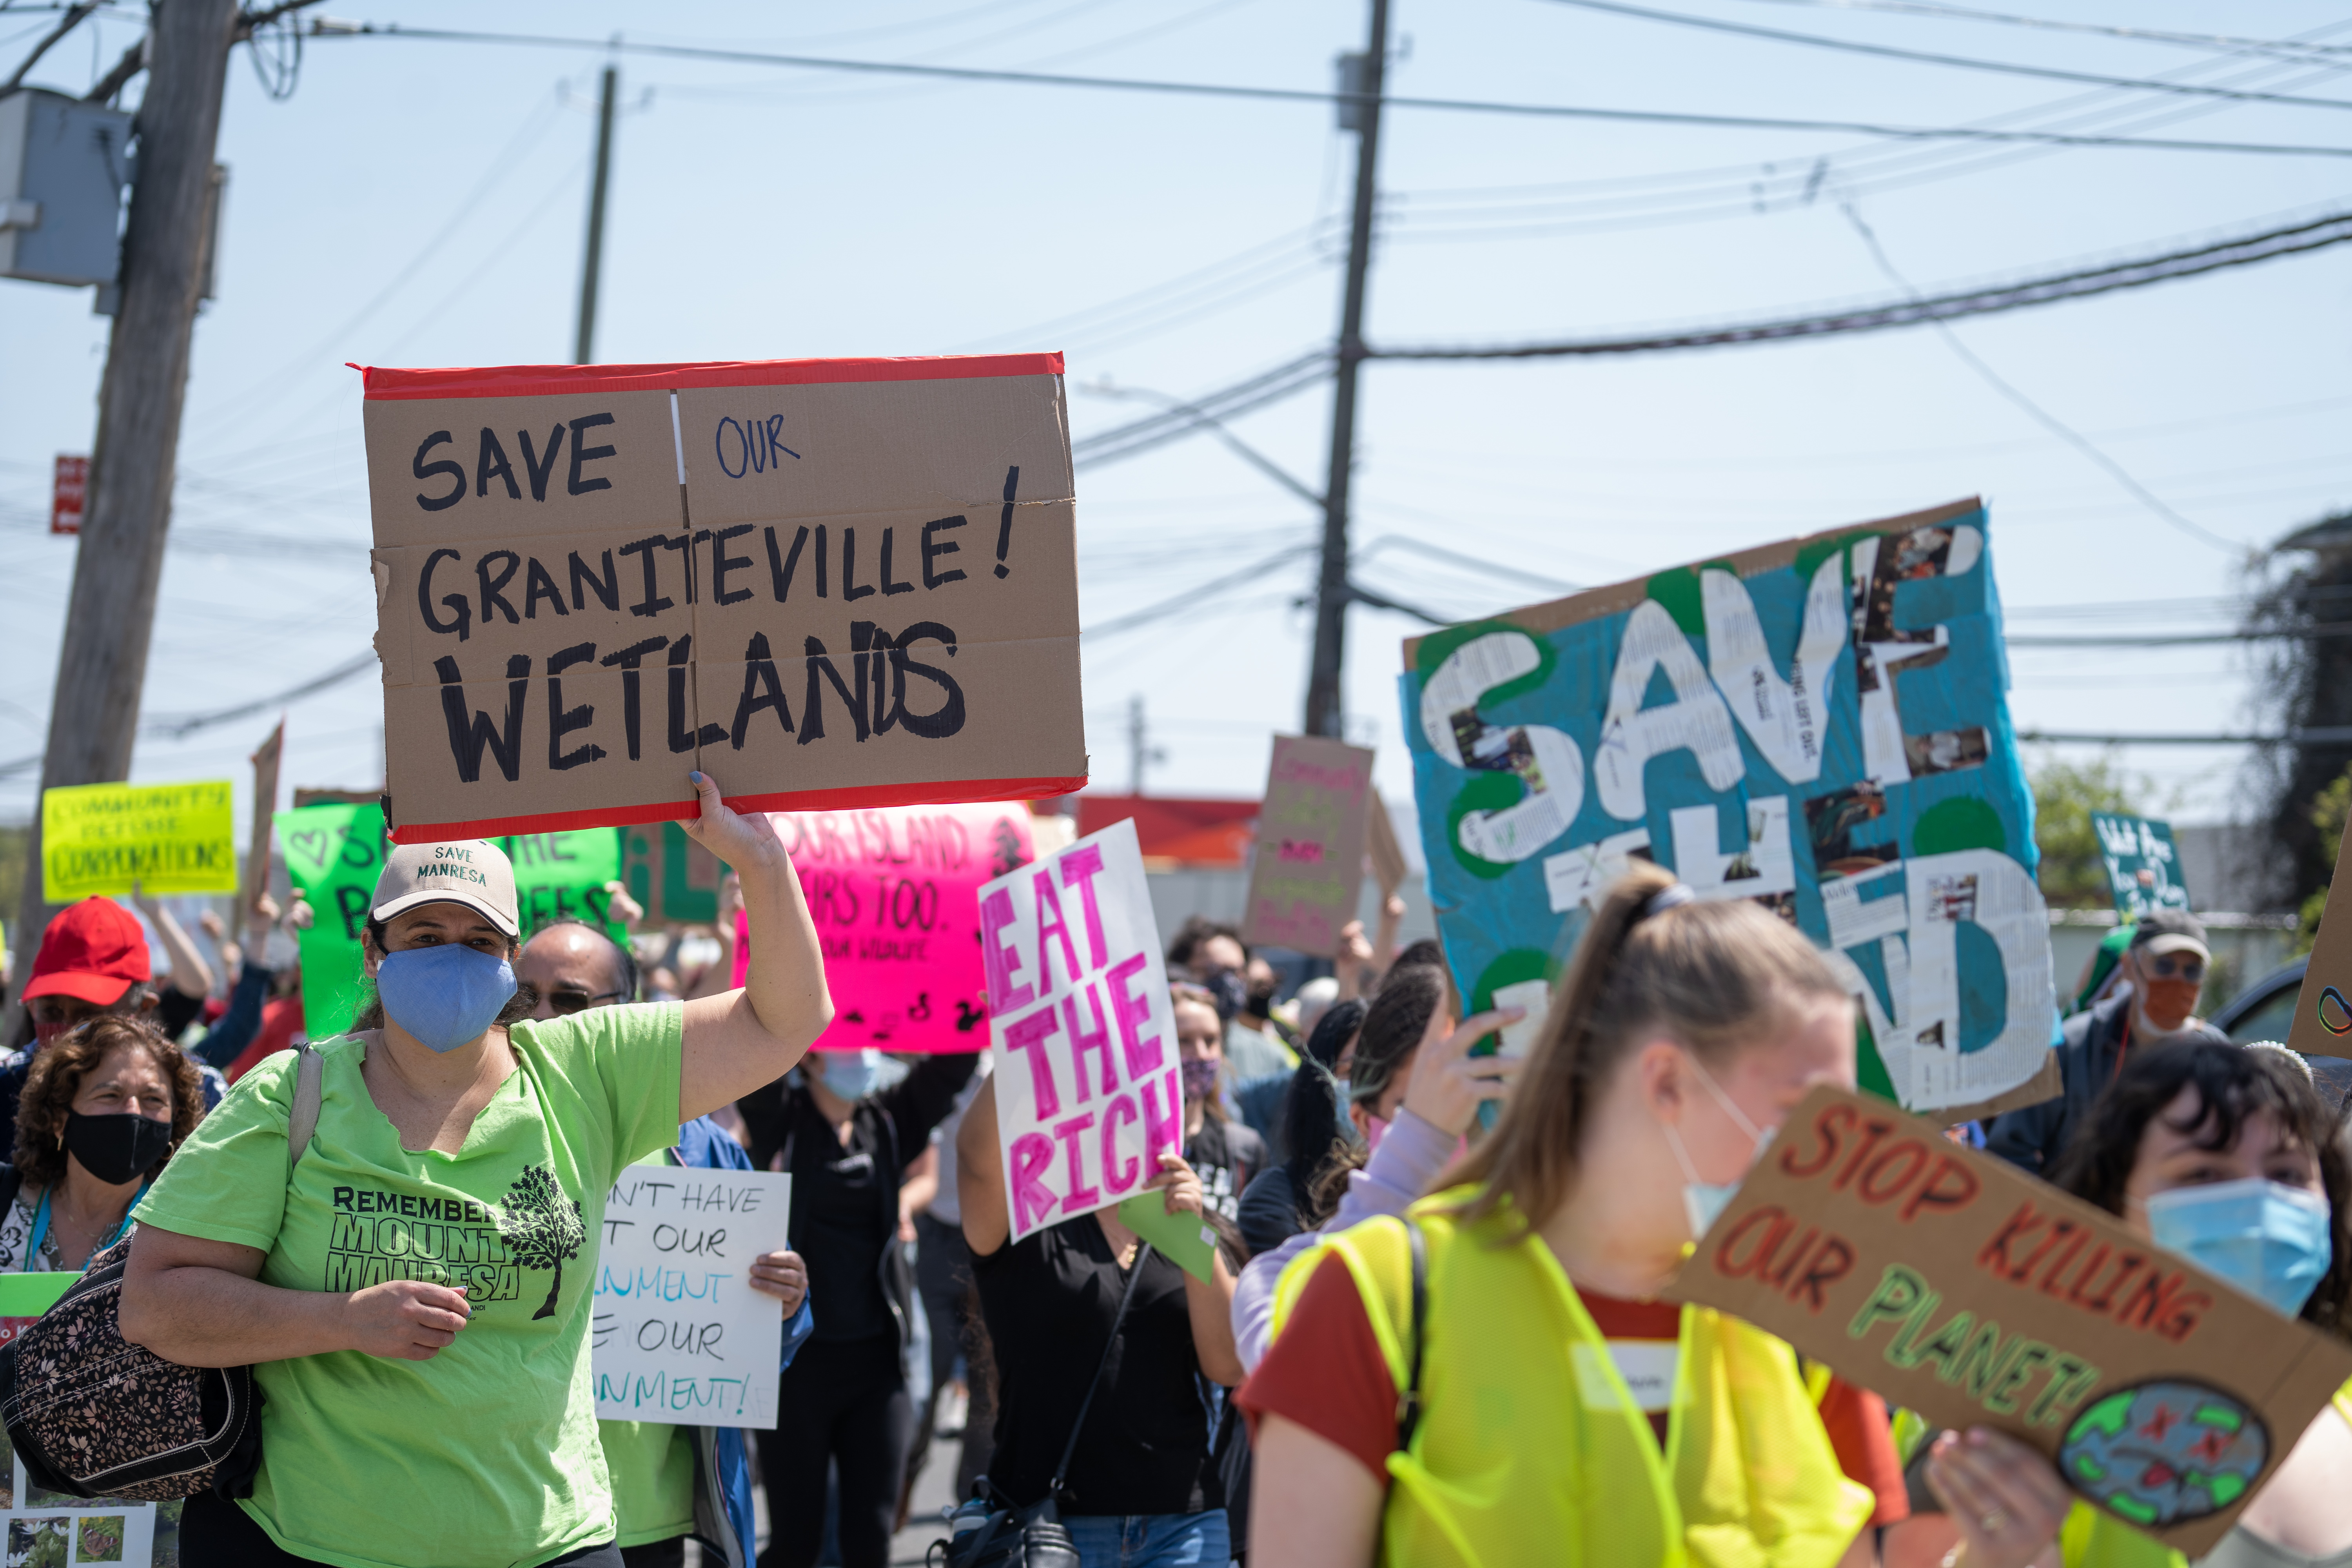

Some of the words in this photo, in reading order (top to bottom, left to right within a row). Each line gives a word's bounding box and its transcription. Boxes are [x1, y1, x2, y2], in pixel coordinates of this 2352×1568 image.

[412, 412, 617, 511] SAVE
[715, 414, 800, 479] OUR
[433, 621, 965, 783] WETLANDS
[1420, 524, 1993, 864] SAVE
[435, 846, 474, 864] SAVE
[853, 810, 971, 871] ISLAND
[417, 863, 486, 887] MANRESA
[980, 843, 1108, 1018] EAT
[1003, 952, 1164, 1122] THE
[1009, 1067, 1184, 1236] RICH
[608, 1181, 675, 1207] N'T
[681, 1182, 765, 1212] HAVE
[1780, 1103, 1982, 1226] STOP
[1976, 1200, 2213, 1345] KILLING
[330, 1212, 510, 1263] MOUNT
[653, 1224, 725, 1257] OUR
[1712, 1205, 1858, 1314] OUR
[325, 1251, 519, 1302] MANRESA
[593, 1265, 733, 1303] NMENT
[637, 1318, 724, 1361] OUR
[593, 1370, 751, 1415] NMENT!
